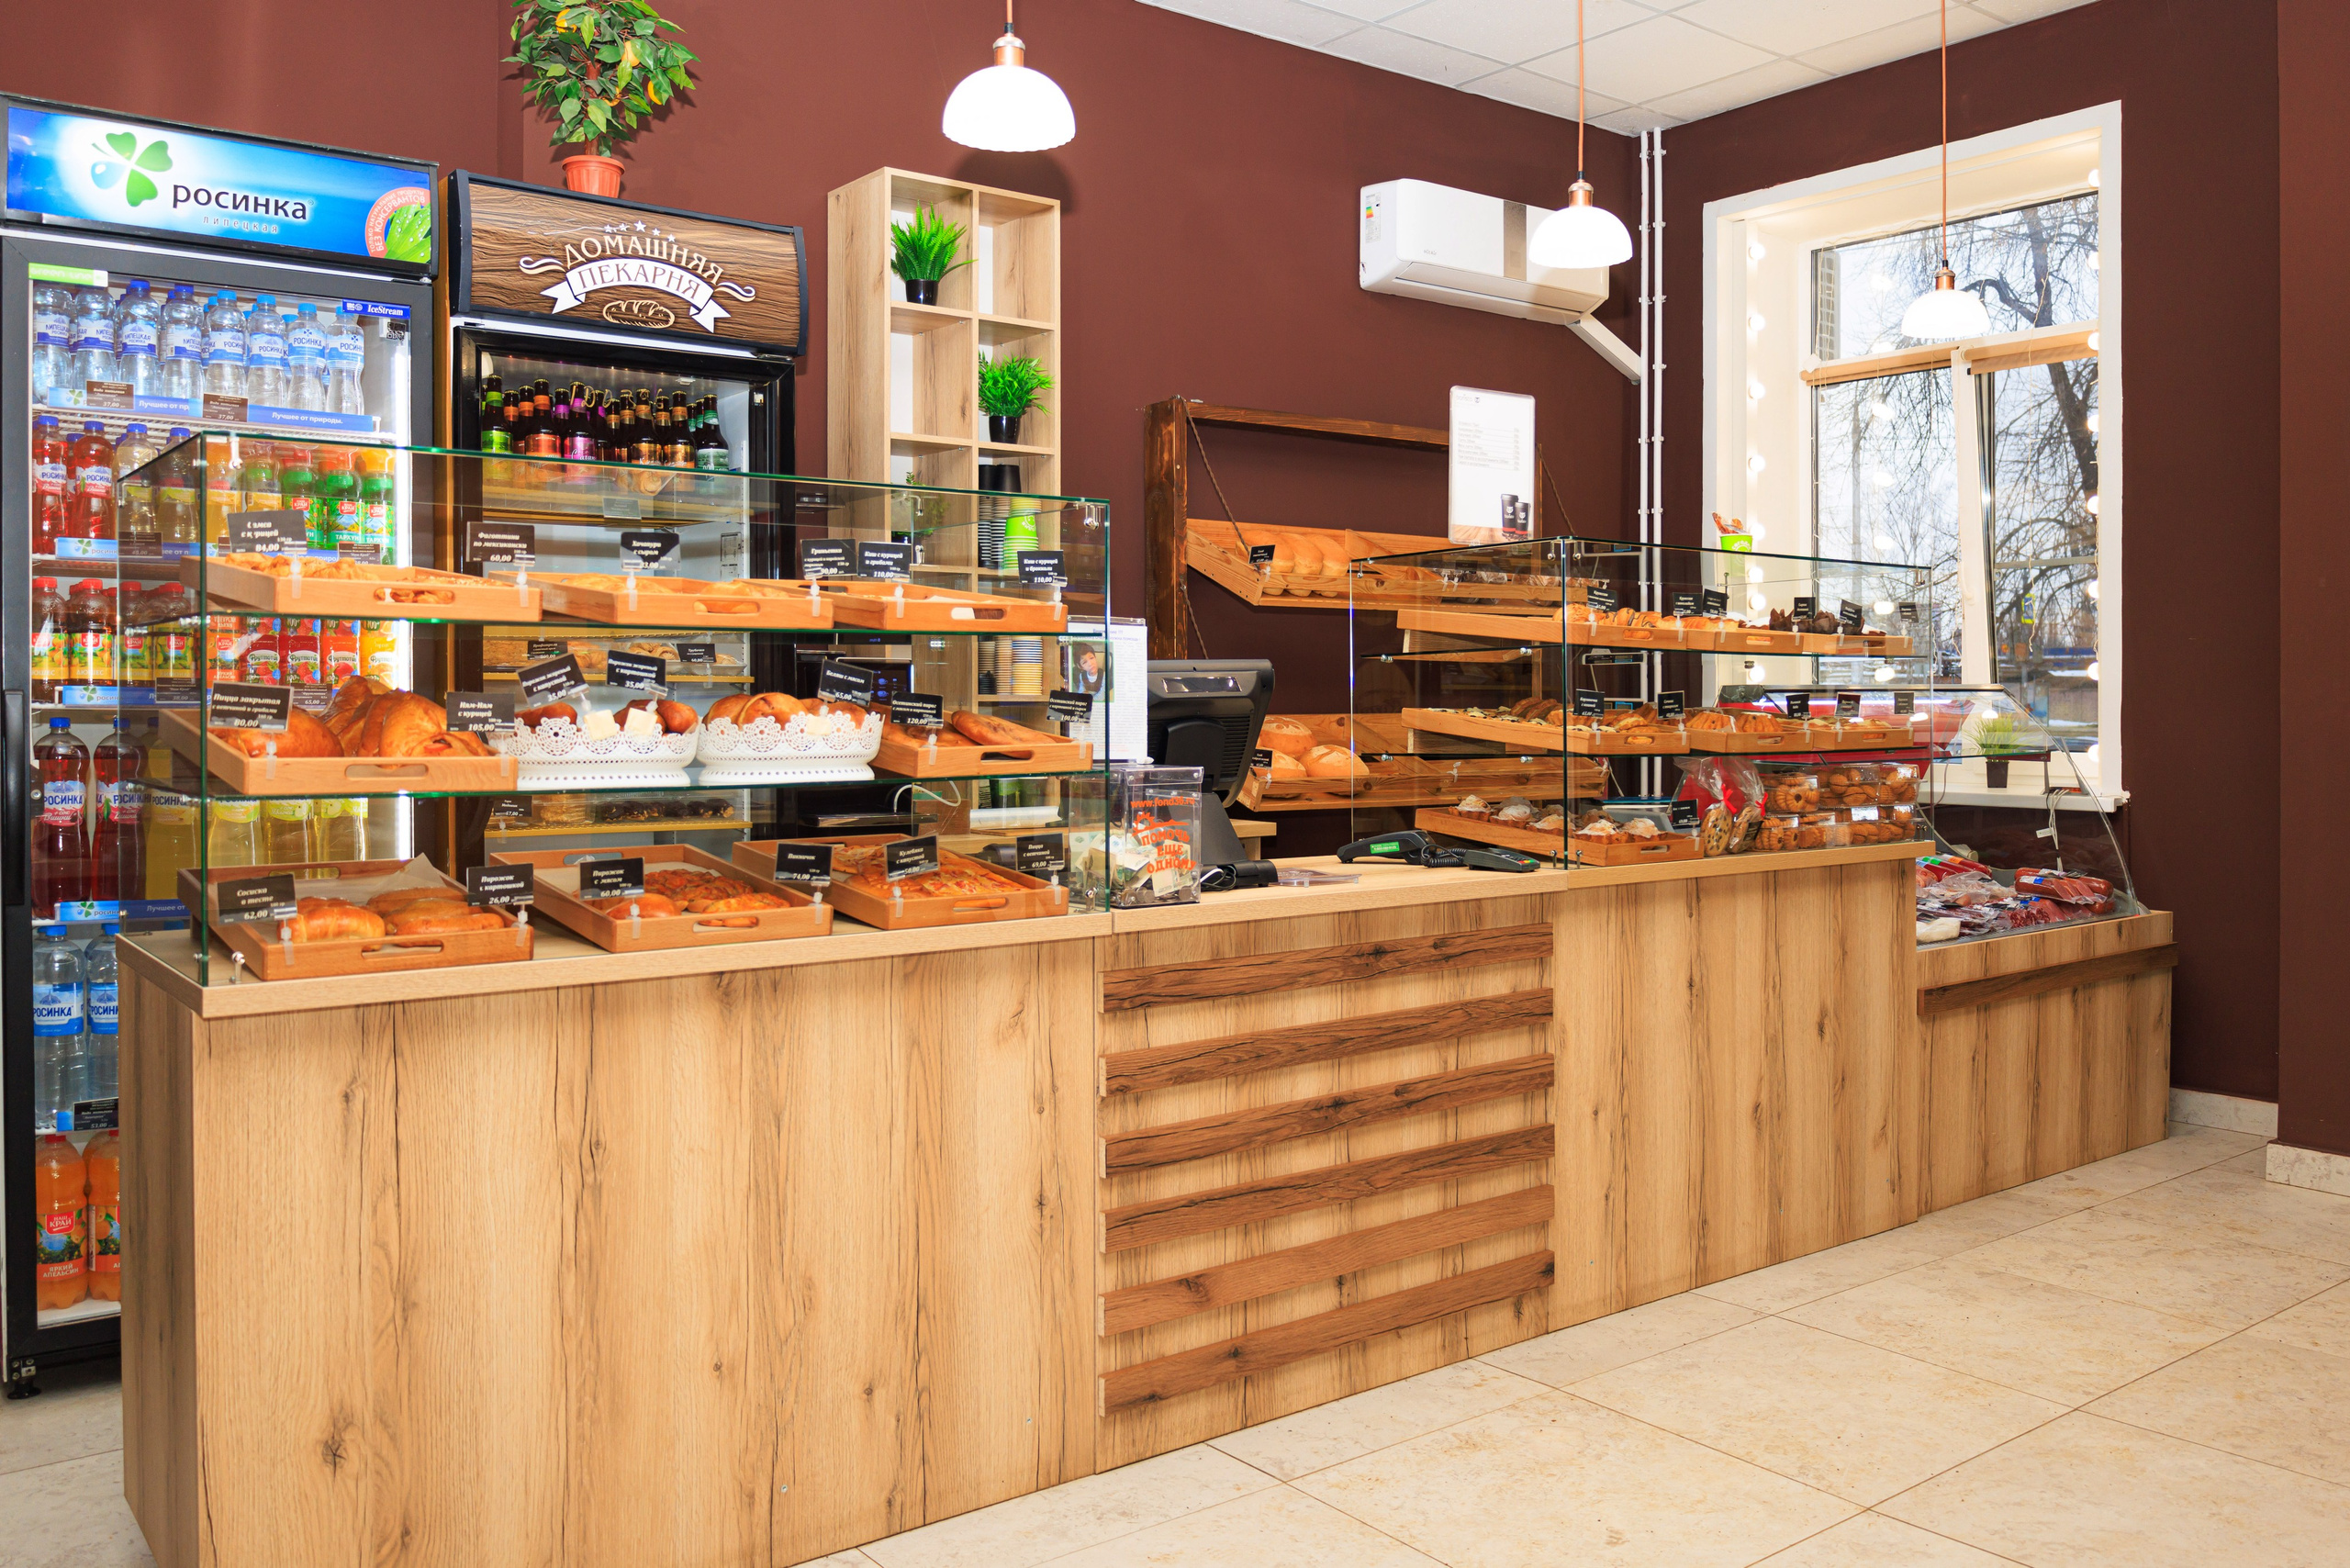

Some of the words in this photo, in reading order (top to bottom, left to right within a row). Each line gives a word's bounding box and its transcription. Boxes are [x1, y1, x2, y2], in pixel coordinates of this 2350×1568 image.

[173, 184, 308, 220] росинка
[374, 195, 425, 233] КОНСЕРВАНТОВ
[203, 216, 279, 234] липецкая
[368, 228, 376, 252] ТОЛЬКО
[374, 236, 385, 252] БЕЗ
[564, 235, 724, 286] ДОМАШНЯЯ
[577, 261, 702, 301] ПЕКАРНЯ
[367, 304, 404, 317] IceStream
[139, 399, 168, 409] Лучшее
[272, 411, 299, 421] Лучшее
[309, 416, 343, 425] природы.
[489, 554, 512, 563] 60,00
[213, 692, 240, 704] Пицца
[239, 695, 282, 706] закрытая
[907, 717, 928, 725] 120,00
[468, 723, 495, 732] 105,00
[1130, 796, 1196, 810] www.fond36.ru
[1140, 828, 1191, 846] ПОМОЧЬ
[1028, 843, 1044, 851] Пицца
[1031, 860, 1047, 868] 69,00
[1147, 857, 1197, 874] ОДНОМУ
[592, 868, 625, 878] Пирожок
[481, 874, 515, 884] Пирожок
[599, 876, 623, 885] мясом
[484, 880, 525, 891] картошкой
[237, 887, 268, 897] Сосиска
[600, 889, 622, 898] 60,00
[247, 896, 274, 905] тесте
[488, 895, 510, 905] 26,00
[147, 904, 175, 913] Лучшее
[243, 909, 268, 921] 62,00
[49, 1217, 73, 1228] КРАЙ
[42, 1267, 79, 1279] АПЕЛЬСИН
[49, 1263, 73, 1272] ЯРКИЙ
